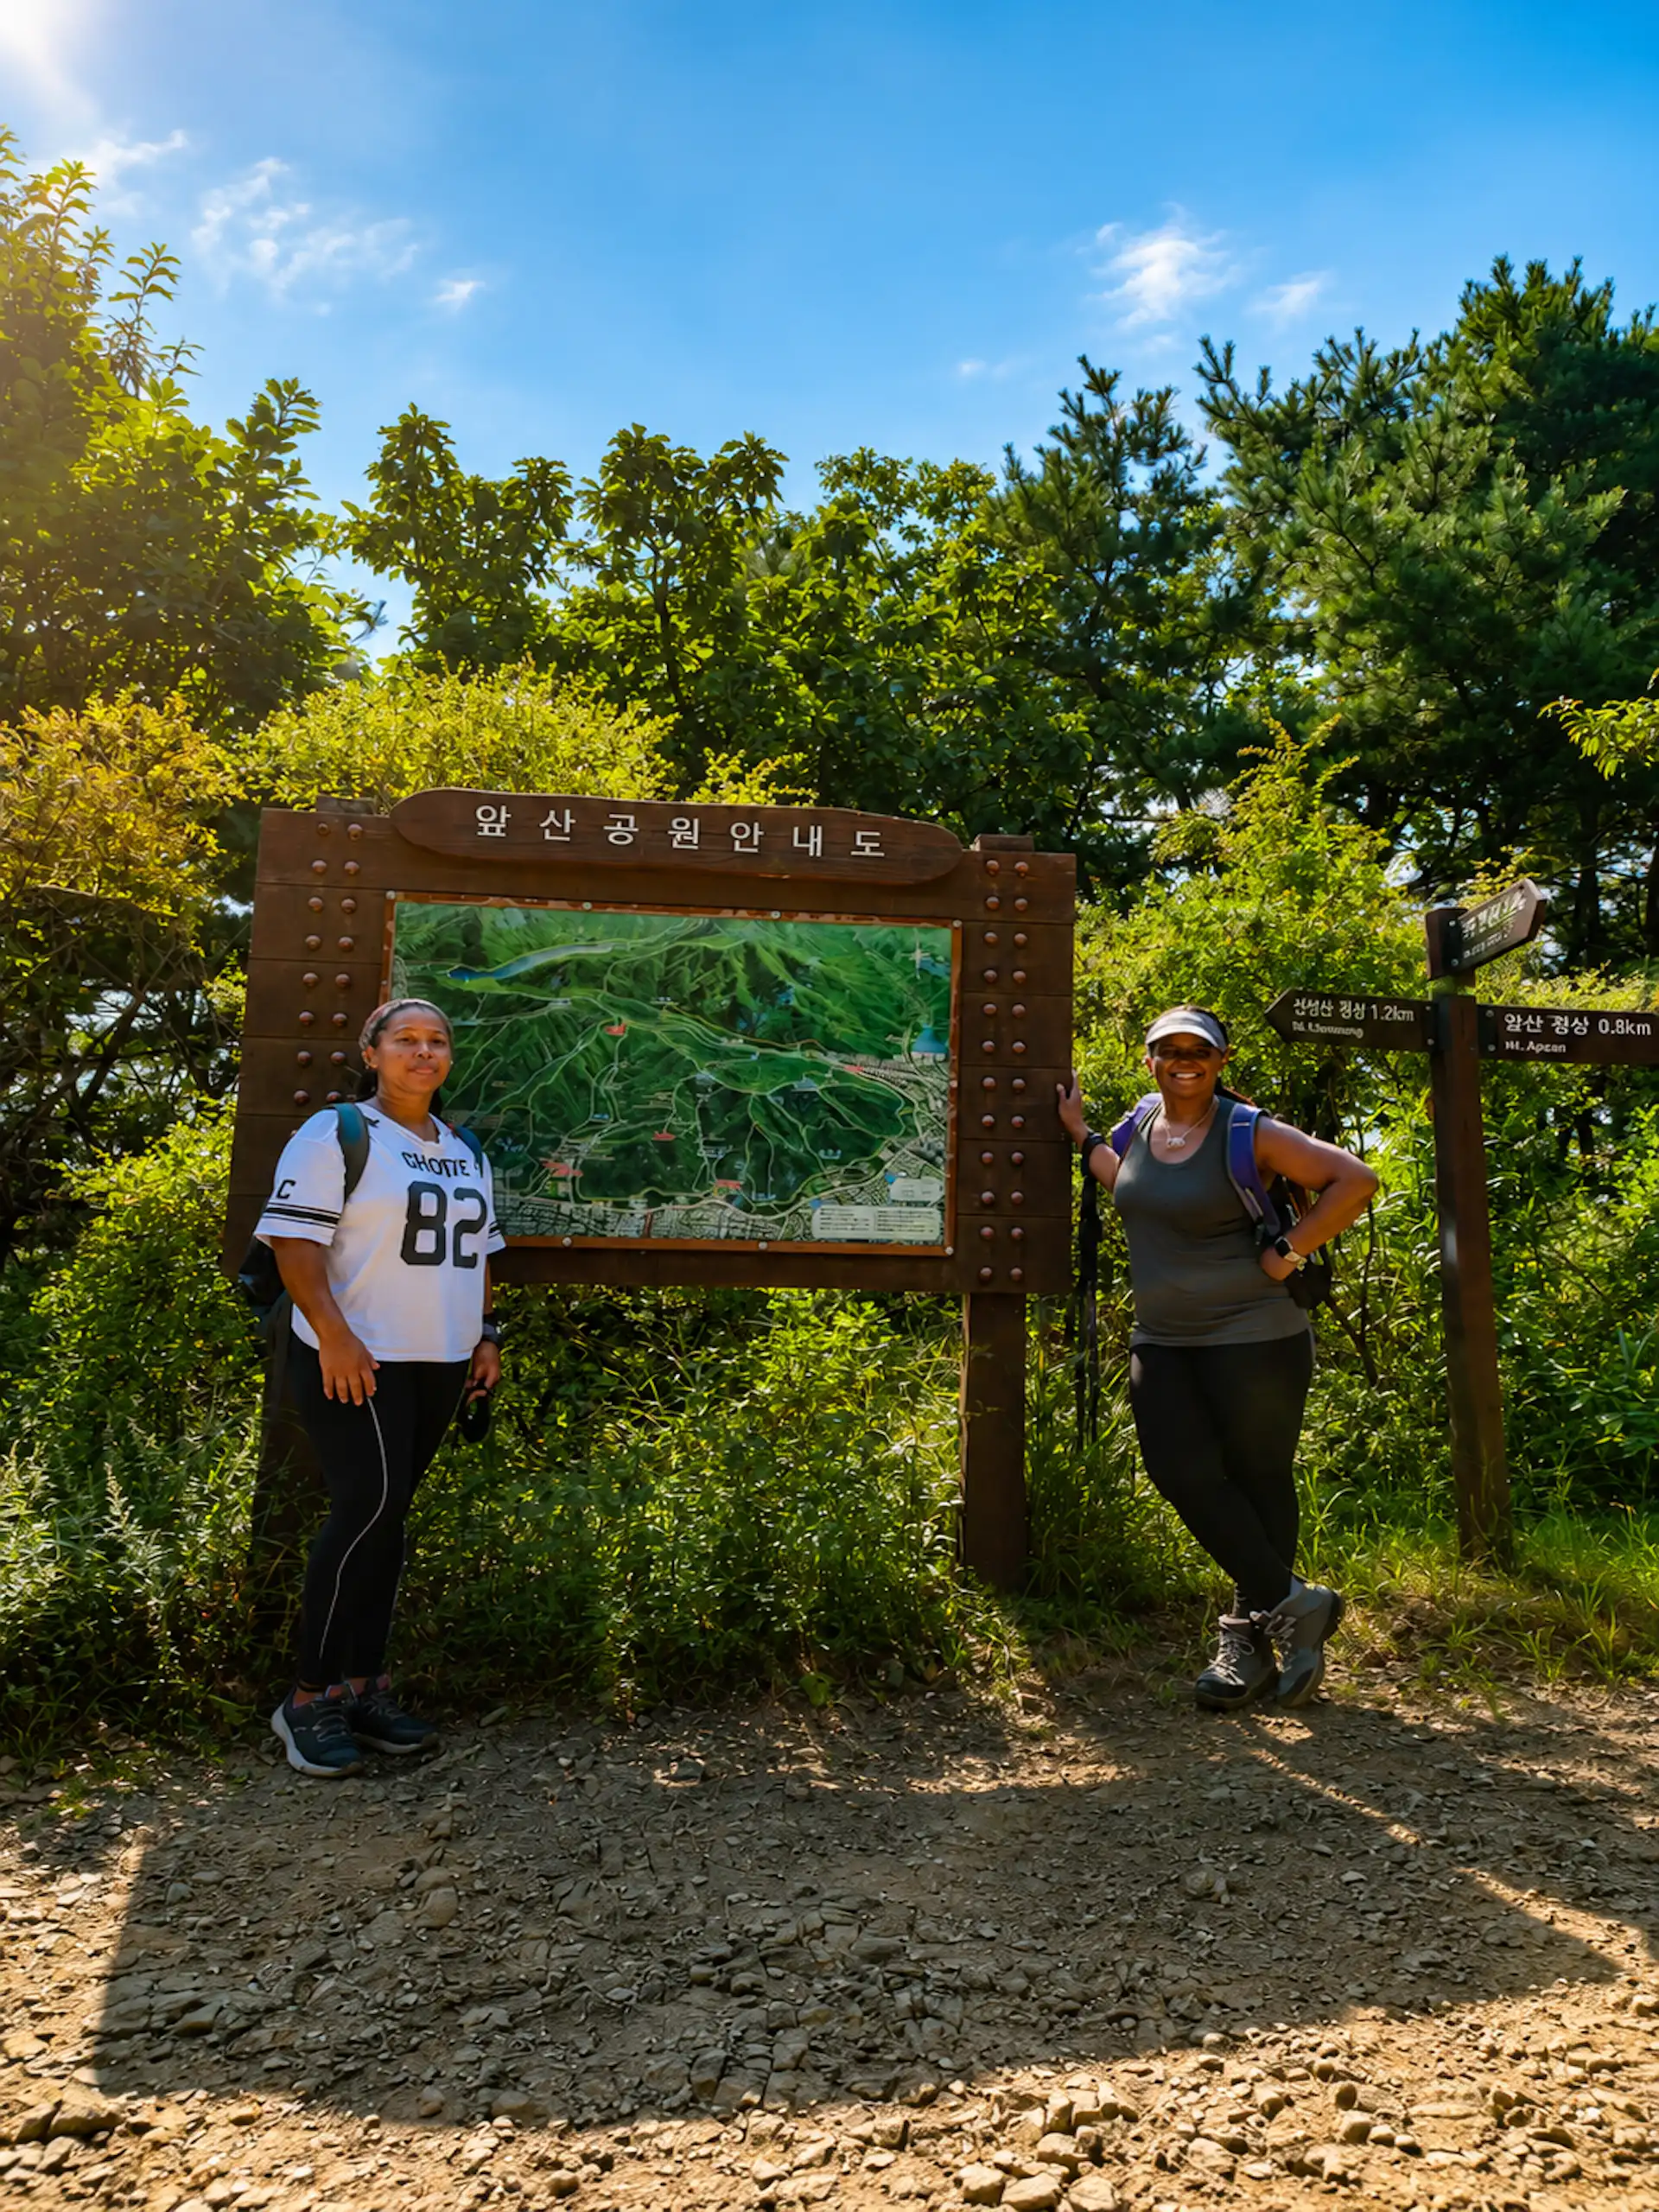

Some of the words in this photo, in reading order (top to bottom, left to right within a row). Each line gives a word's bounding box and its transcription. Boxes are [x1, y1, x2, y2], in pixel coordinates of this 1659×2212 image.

[1370, 1003, 1414, 1022] 1.2km
[1598, 1018, 1651, 1036] 0.8km
[276, 1179, 296, 1199] C
[400, 1180, 488, 1269] 82
